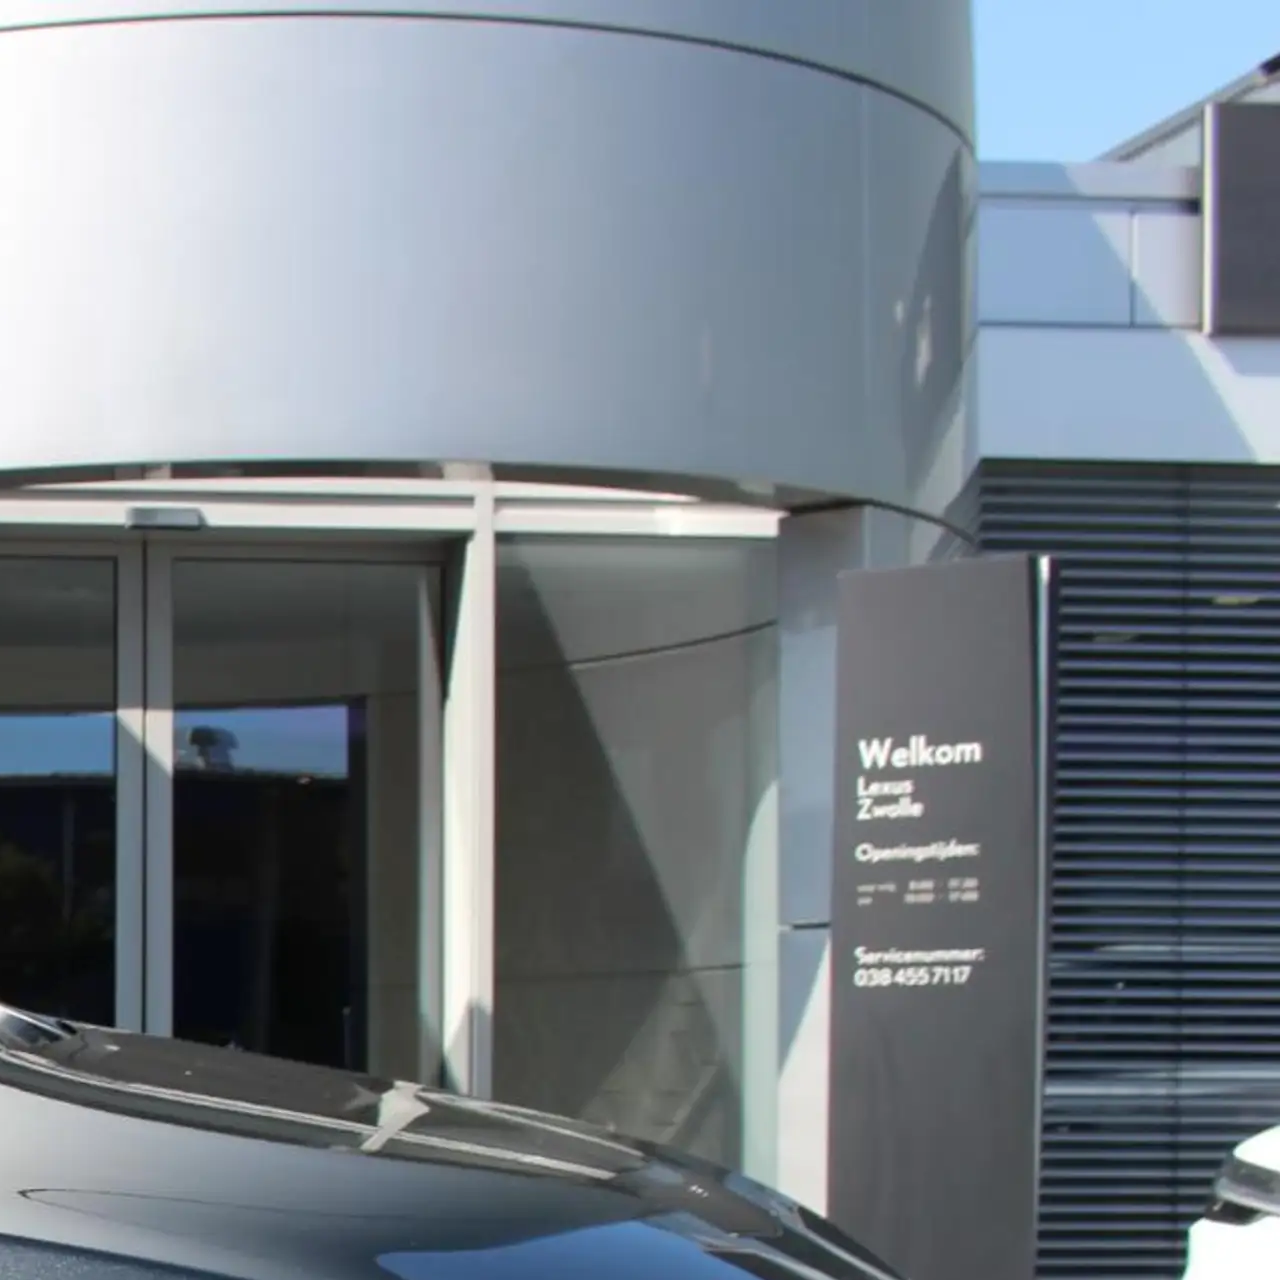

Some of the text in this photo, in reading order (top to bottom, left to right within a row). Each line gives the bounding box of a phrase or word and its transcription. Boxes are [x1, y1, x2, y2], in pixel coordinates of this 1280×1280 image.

[857, 735, 982, 769] Welkom
[857, 775, 915, 797] Lexus
[856, 796, 924, 820] Zwolle
